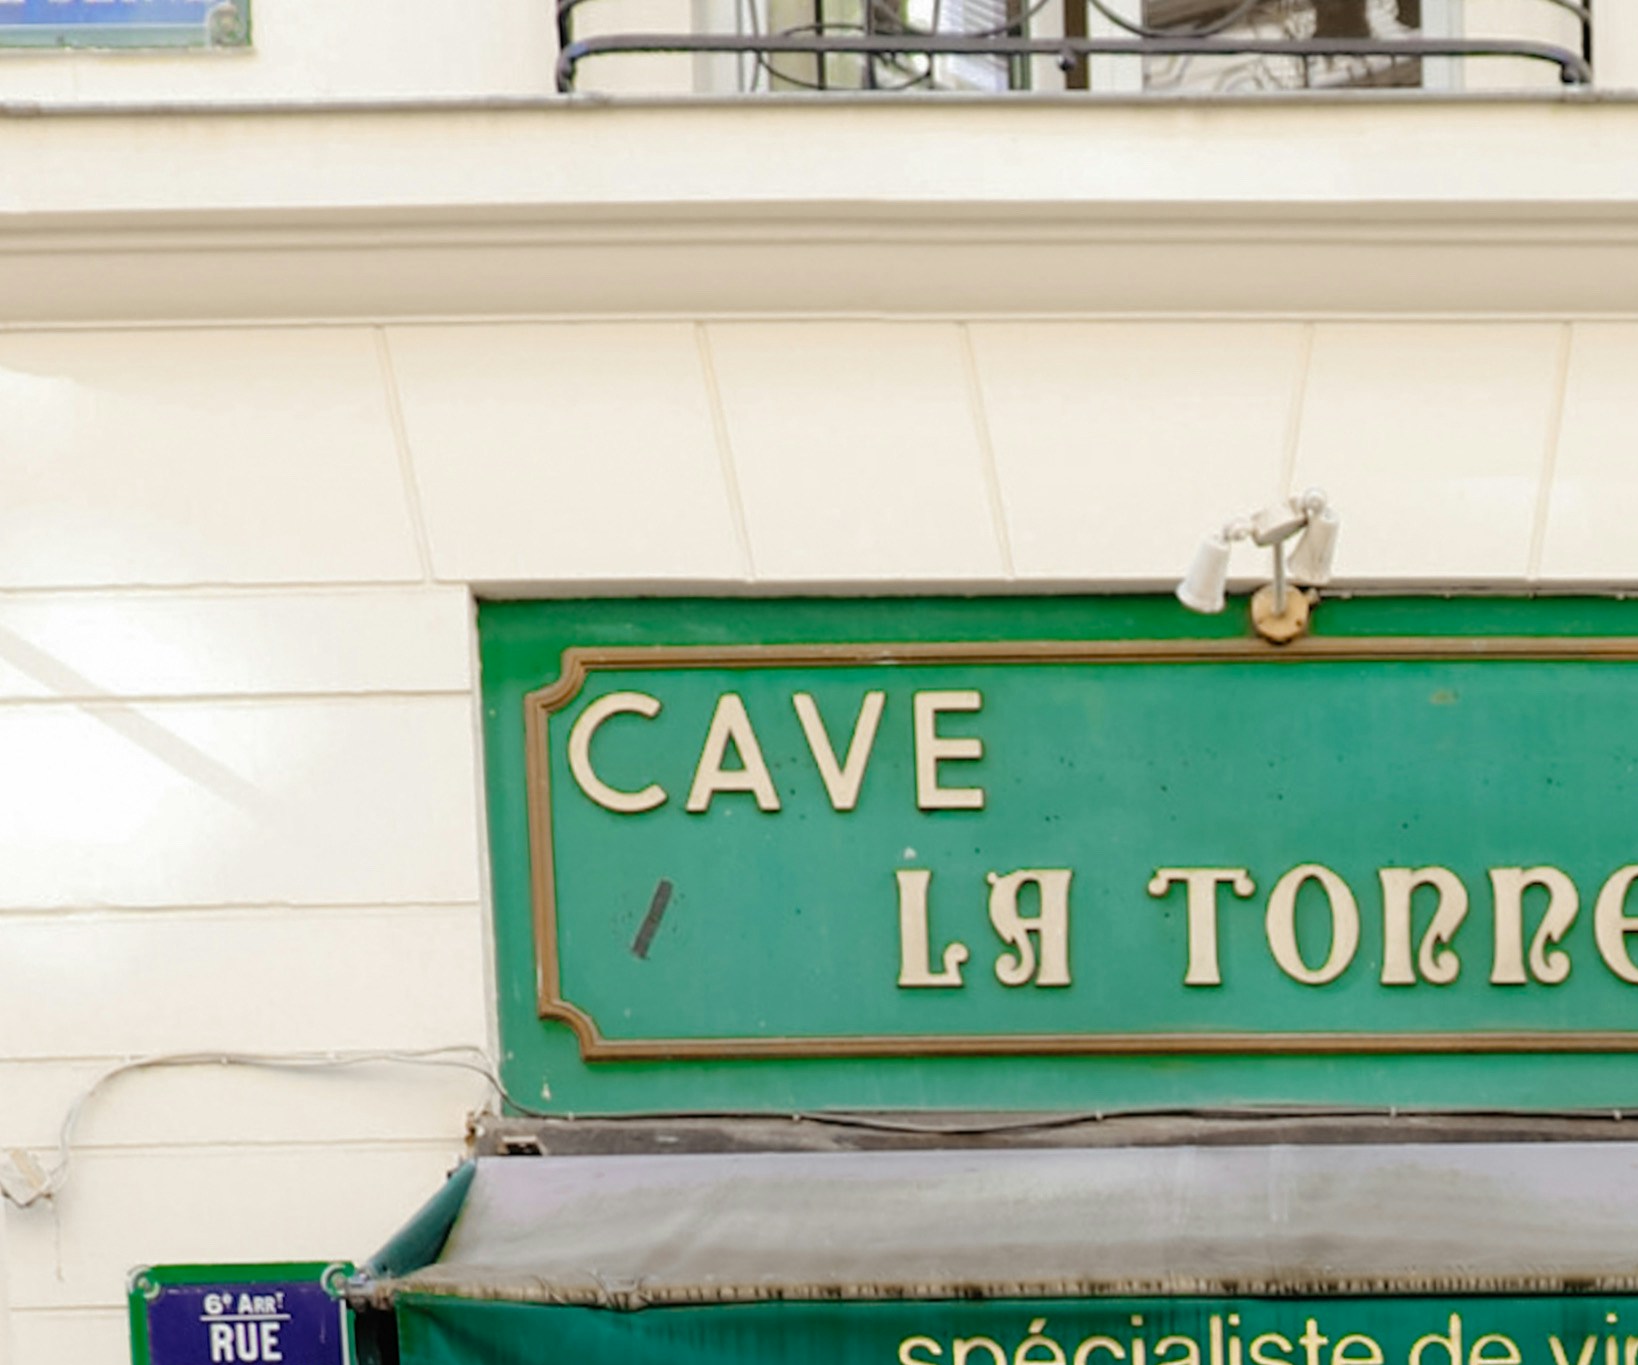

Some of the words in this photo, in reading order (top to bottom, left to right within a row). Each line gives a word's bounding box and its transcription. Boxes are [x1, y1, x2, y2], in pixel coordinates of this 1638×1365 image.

[566, 689, 987, 814] CAVE
[895, 866, 1074, 989] LA
[210, 1321, 283, 1363] RUE
